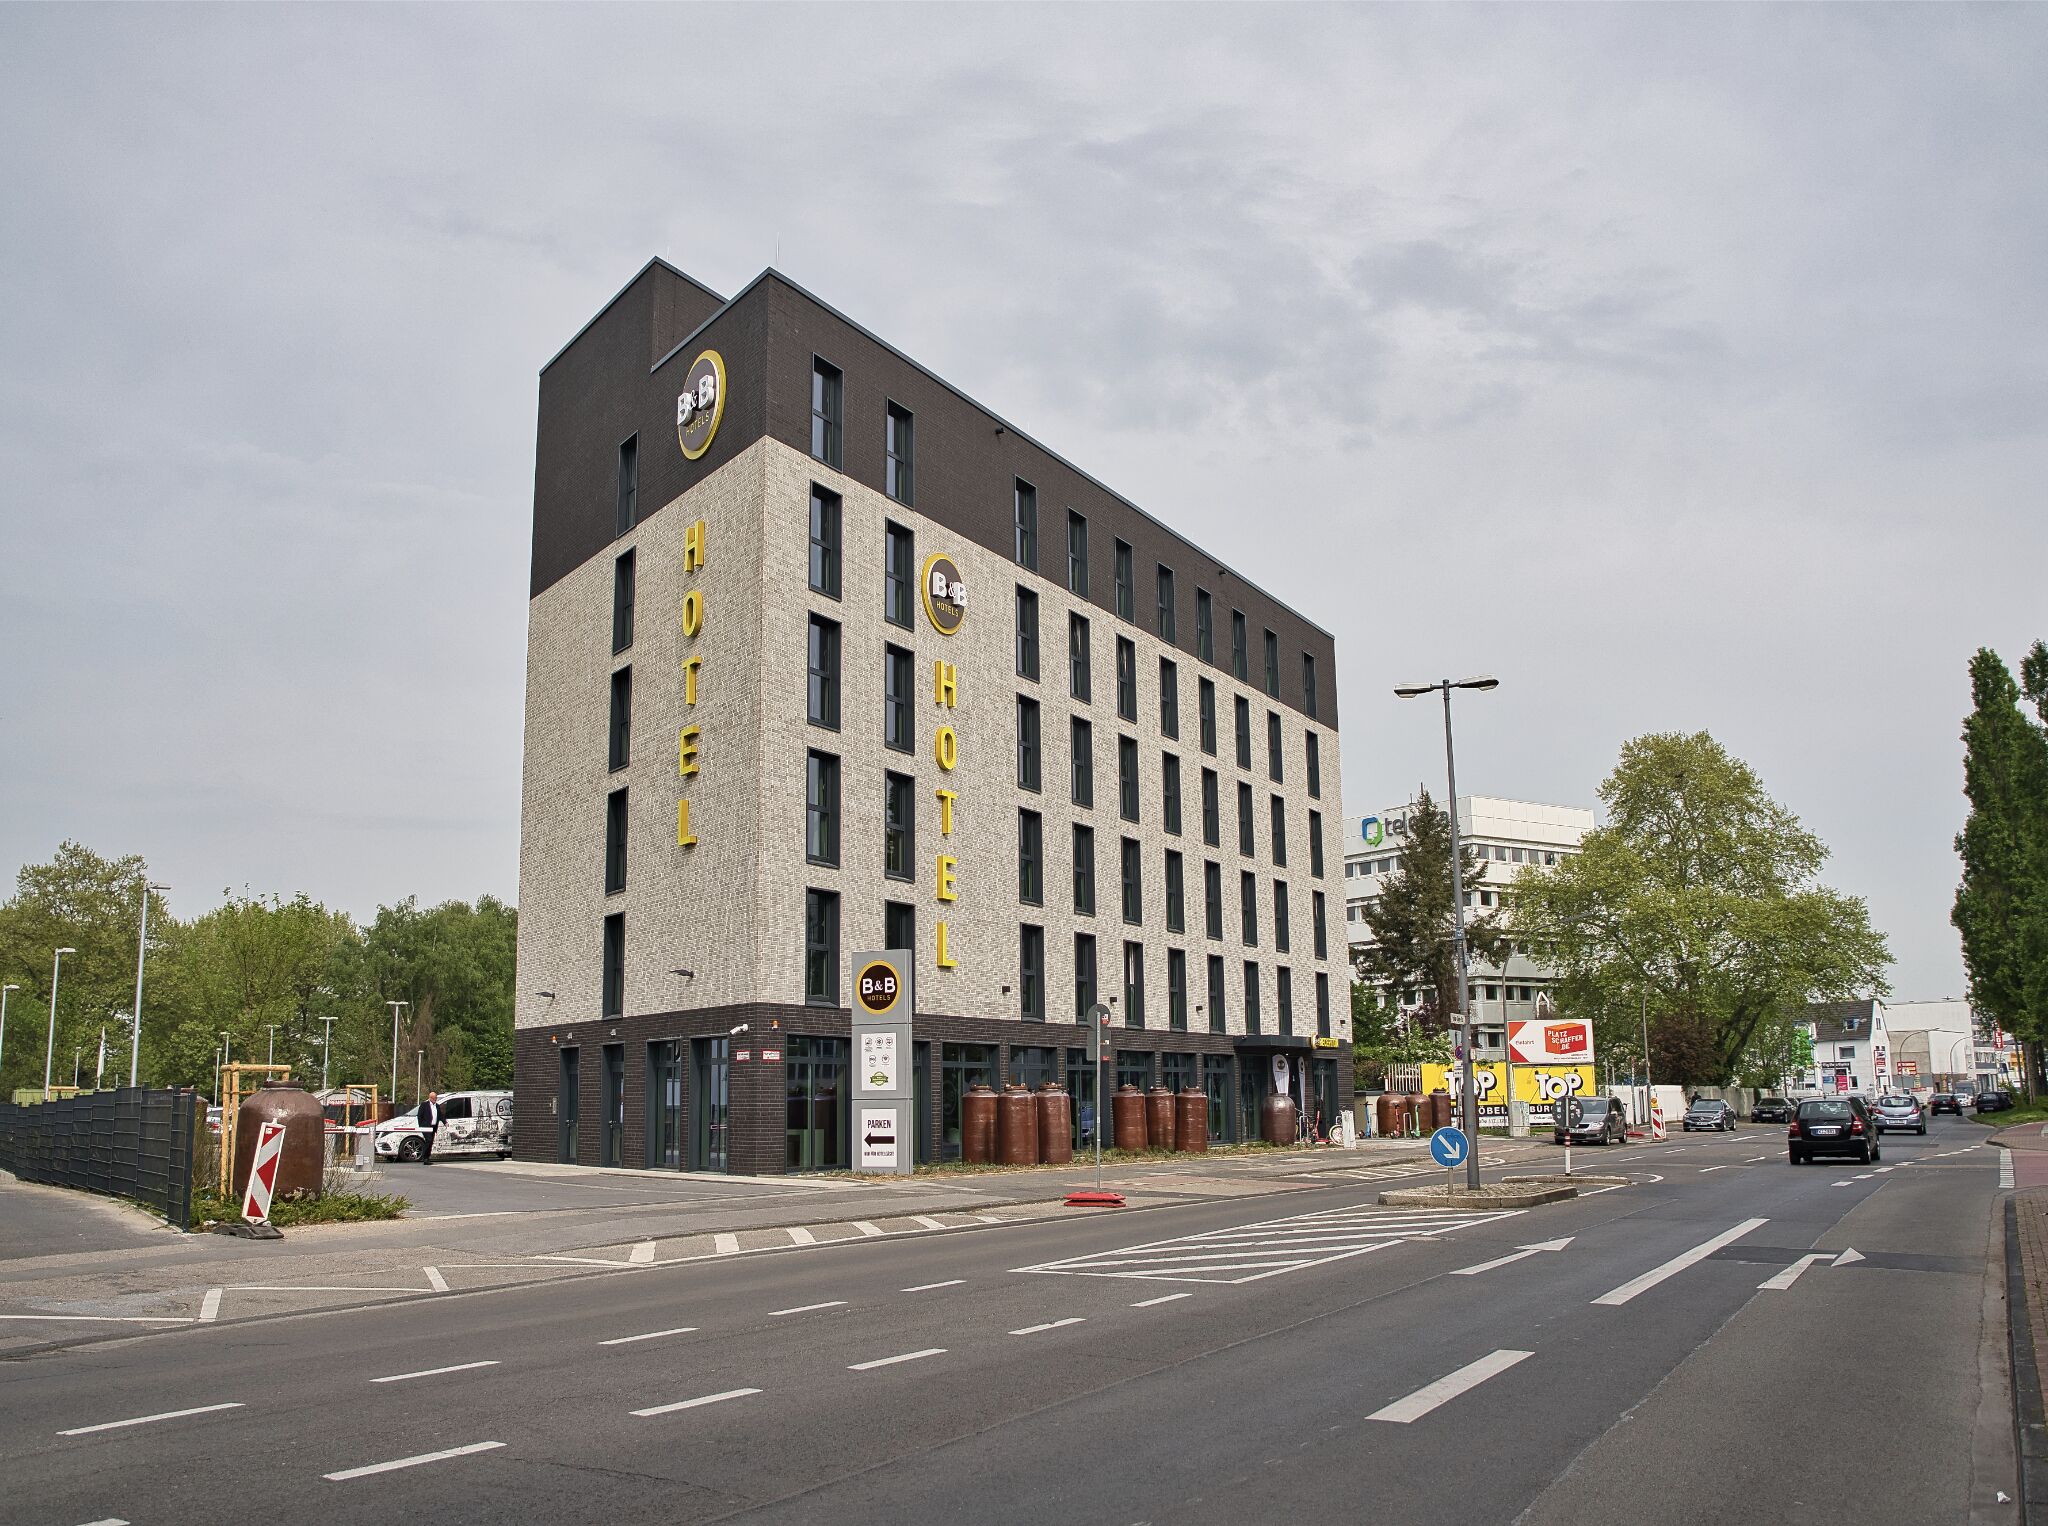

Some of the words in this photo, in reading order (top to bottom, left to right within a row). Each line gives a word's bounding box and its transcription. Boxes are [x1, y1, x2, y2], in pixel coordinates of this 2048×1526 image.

[677, 375, 714, 425] B&B
[686, 411, 710, 437] HOTELS
[932, 571, 967, 606] B&B
[936, 601, 959, 617] HOTELS
[678, 520, 705, 848] HOTEL
[935, 660, 958, 968] HOTEL
[862, 977, 896, 994] B&B
[1547, 1030, 1568, 1038] PLATZ
[1551, 1034, 1584, 1044] SCHAFFEN
[1535, 1072, 1583, 1100] TOP
[1529, 1104, 1553, 1113] BÜR
[867, 1119, 892, 1129] PARKEN
